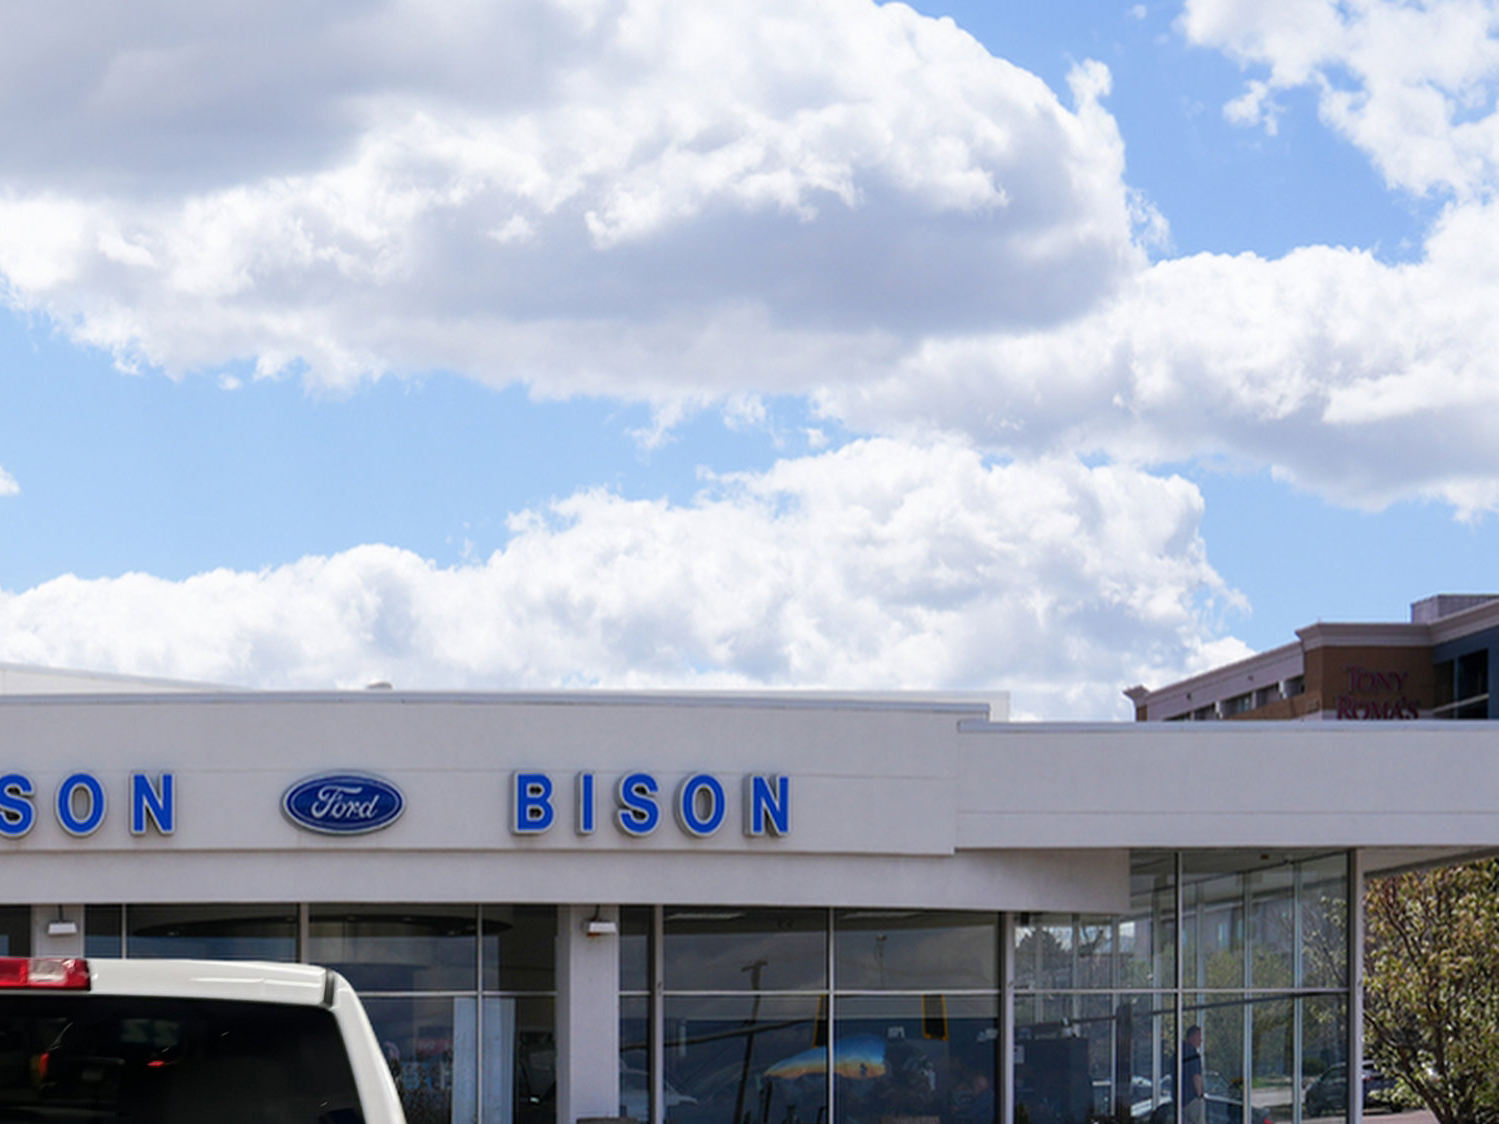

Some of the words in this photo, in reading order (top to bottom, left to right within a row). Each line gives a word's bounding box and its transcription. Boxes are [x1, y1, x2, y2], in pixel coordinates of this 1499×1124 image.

[1344, 664, 1408, 692] TONY
[311, 785, 379, 819] Ford
[512, 771, 791, 836] BISON
